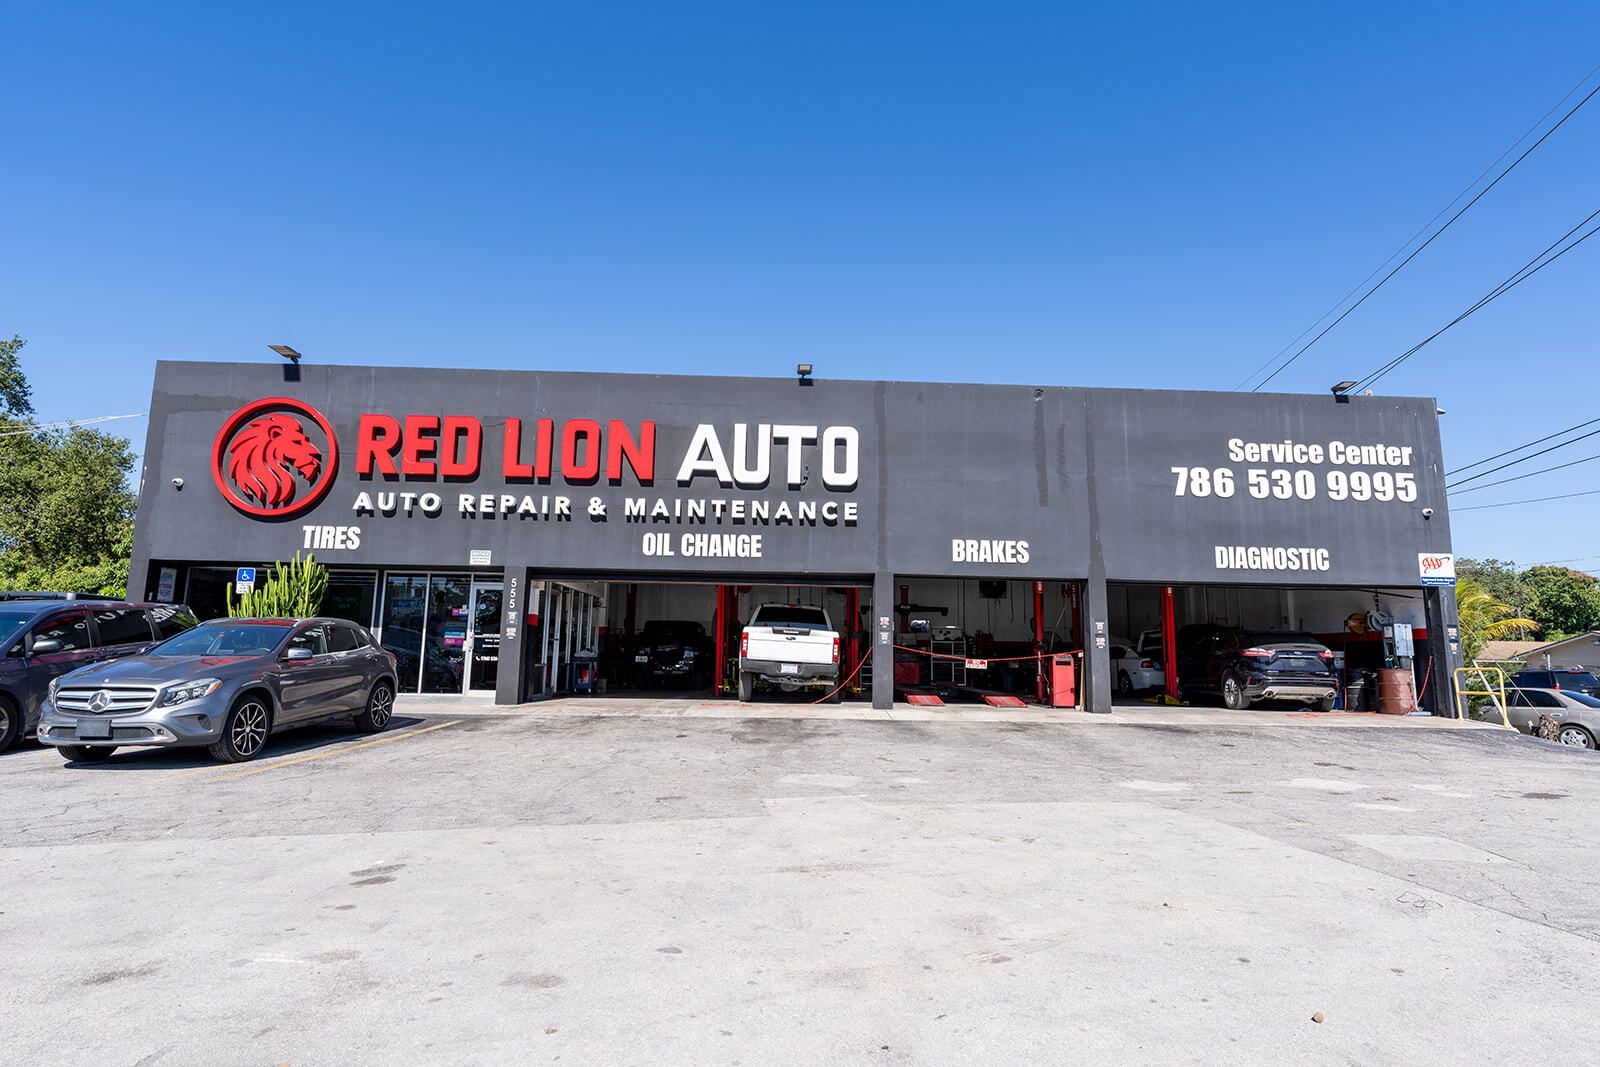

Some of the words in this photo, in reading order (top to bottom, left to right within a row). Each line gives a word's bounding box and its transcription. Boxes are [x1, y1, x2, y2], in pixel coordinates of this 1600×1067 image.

[356, 414, 481, 476] RED
[502, 417, 656, 480] LION
[676, 423, 859, 487] AUTO
[1228, 437, 1324, 465] Service
[1328, 440, 1413, 466] Center
[1170, 466, 1235, 498] 786
[1247, 468, 1316, 500] 530
[1327, 470, 1418, 503] 9995
[352, 491, 441, 513] AUTO
[458, 493, 570, 516] REPAIR
[587, 496, 607, 516] &
[624, 497, 858, 521] MAINTENANCE
[302, 525, 361, 551] TIRES
[642, 532, 675, 556] OIL
[680, 532, 763, 558] CHANGE
[951, 538, 1030, 564] BRAKES
[1214, 545, 1330, 571] DIAGNOSTIC
[509, 577, 518, 609] 555
